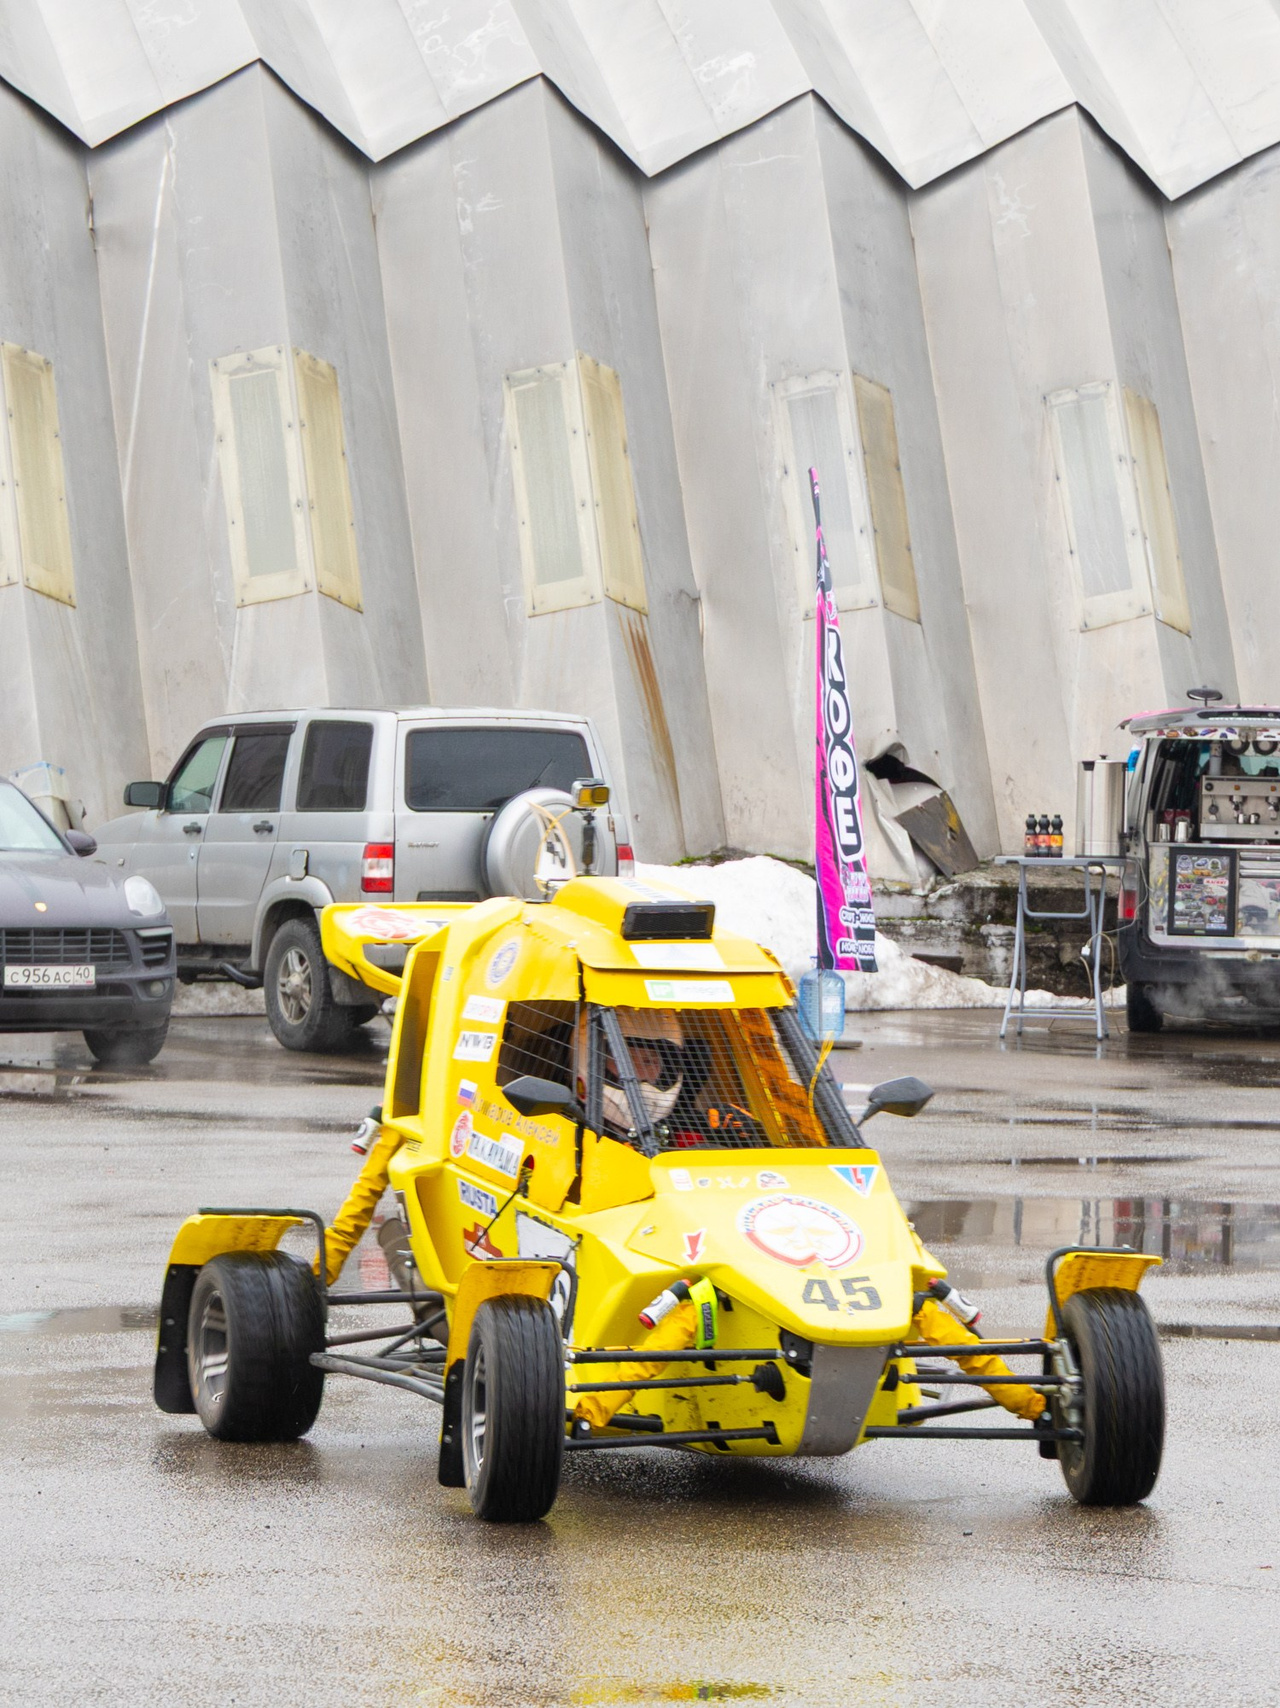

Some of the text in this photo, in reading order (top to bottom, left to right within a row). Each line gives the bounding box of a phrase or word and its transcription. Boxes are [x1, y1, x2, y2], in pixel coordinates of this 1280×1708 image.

[76, 967, 90, 979] 40
[459, 1033, 494, 1050] NWB
[801, 1276, 883, 1312] 45
